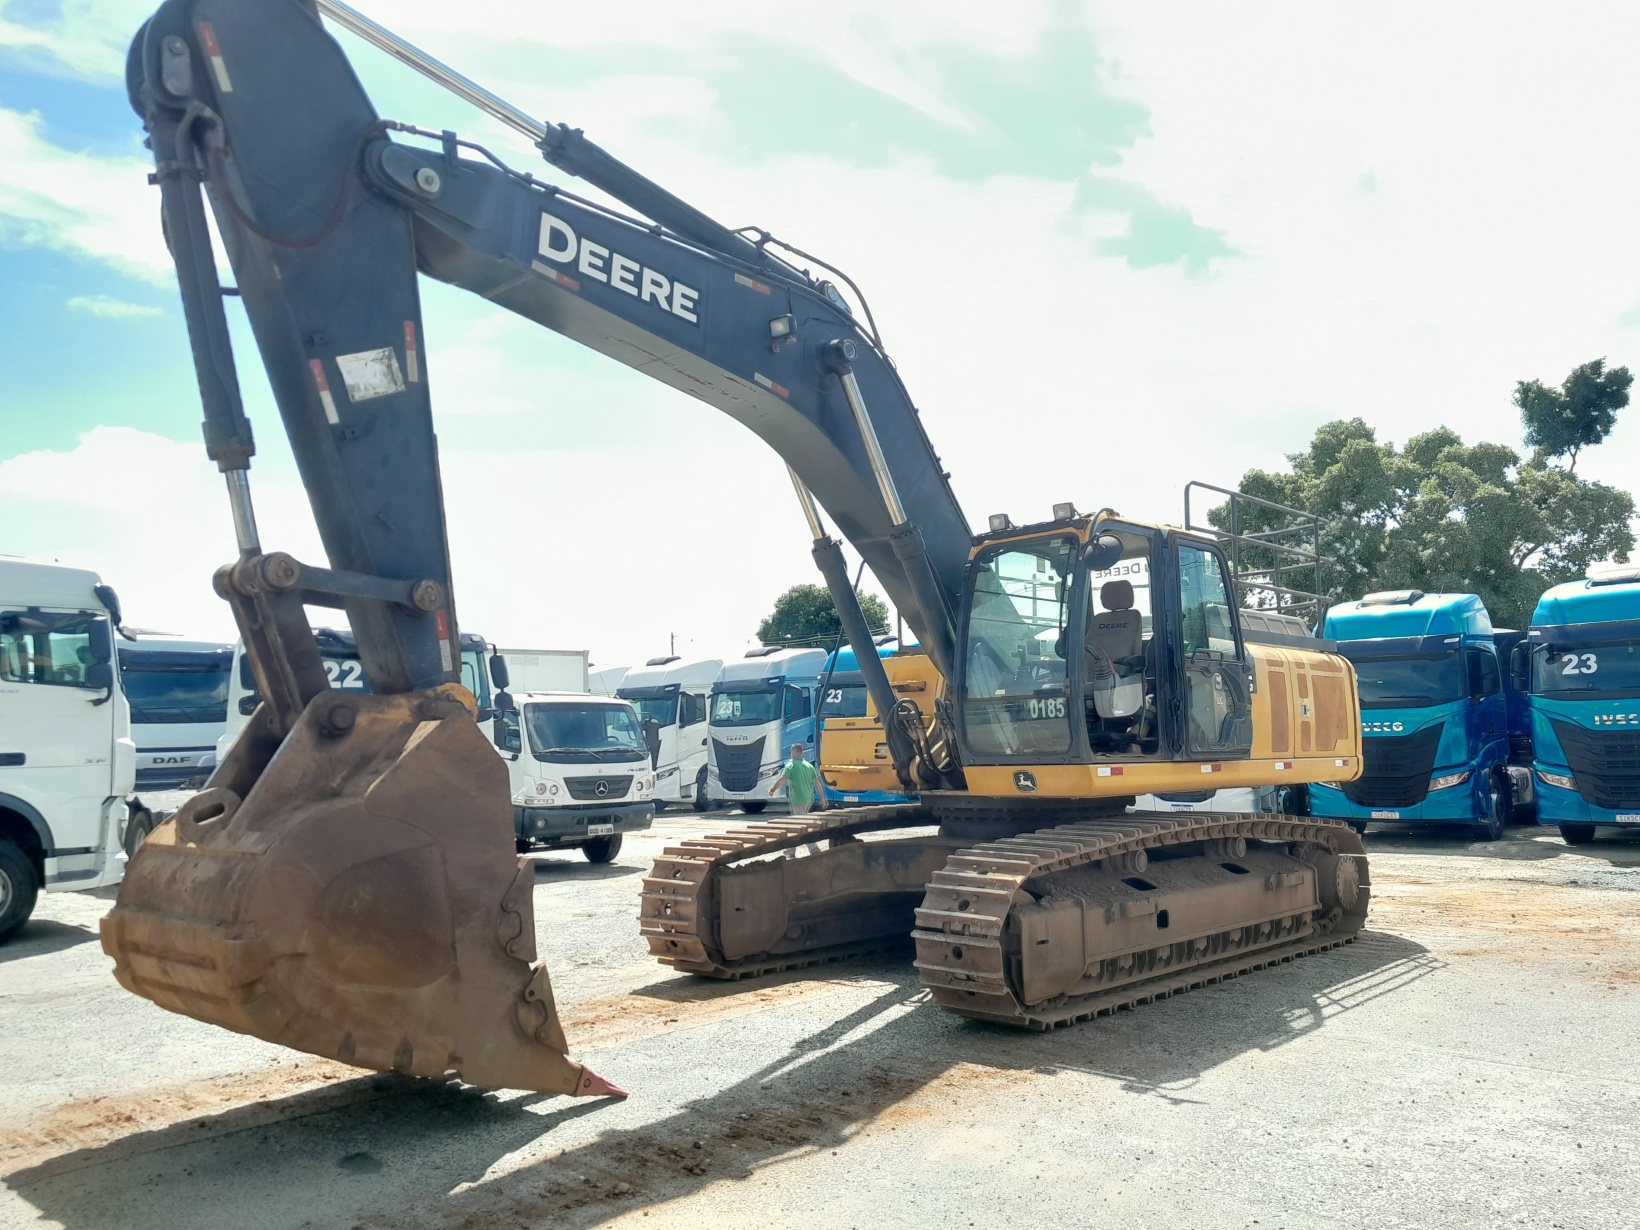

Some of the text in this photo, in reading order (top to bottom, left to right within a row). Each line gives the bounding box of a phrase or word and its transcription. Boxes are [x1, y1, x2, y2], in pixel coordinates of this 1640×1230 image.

[538, 212, 699, 323] DEERE
[1099, 622, 1128, 630] DEERE
[1561, 653, 1598, 675] 23
[322, 660, 364, 688] 22
[826, 689, 843, 703] 23
[719, 701, 734, 714] 23
[1030, 698, 1065, 718] 0185
[1594, 713, 1640, 725] IVEC
[1361, 721, 1404, 731] VECO
[152, 756, 192, 764] DAF
